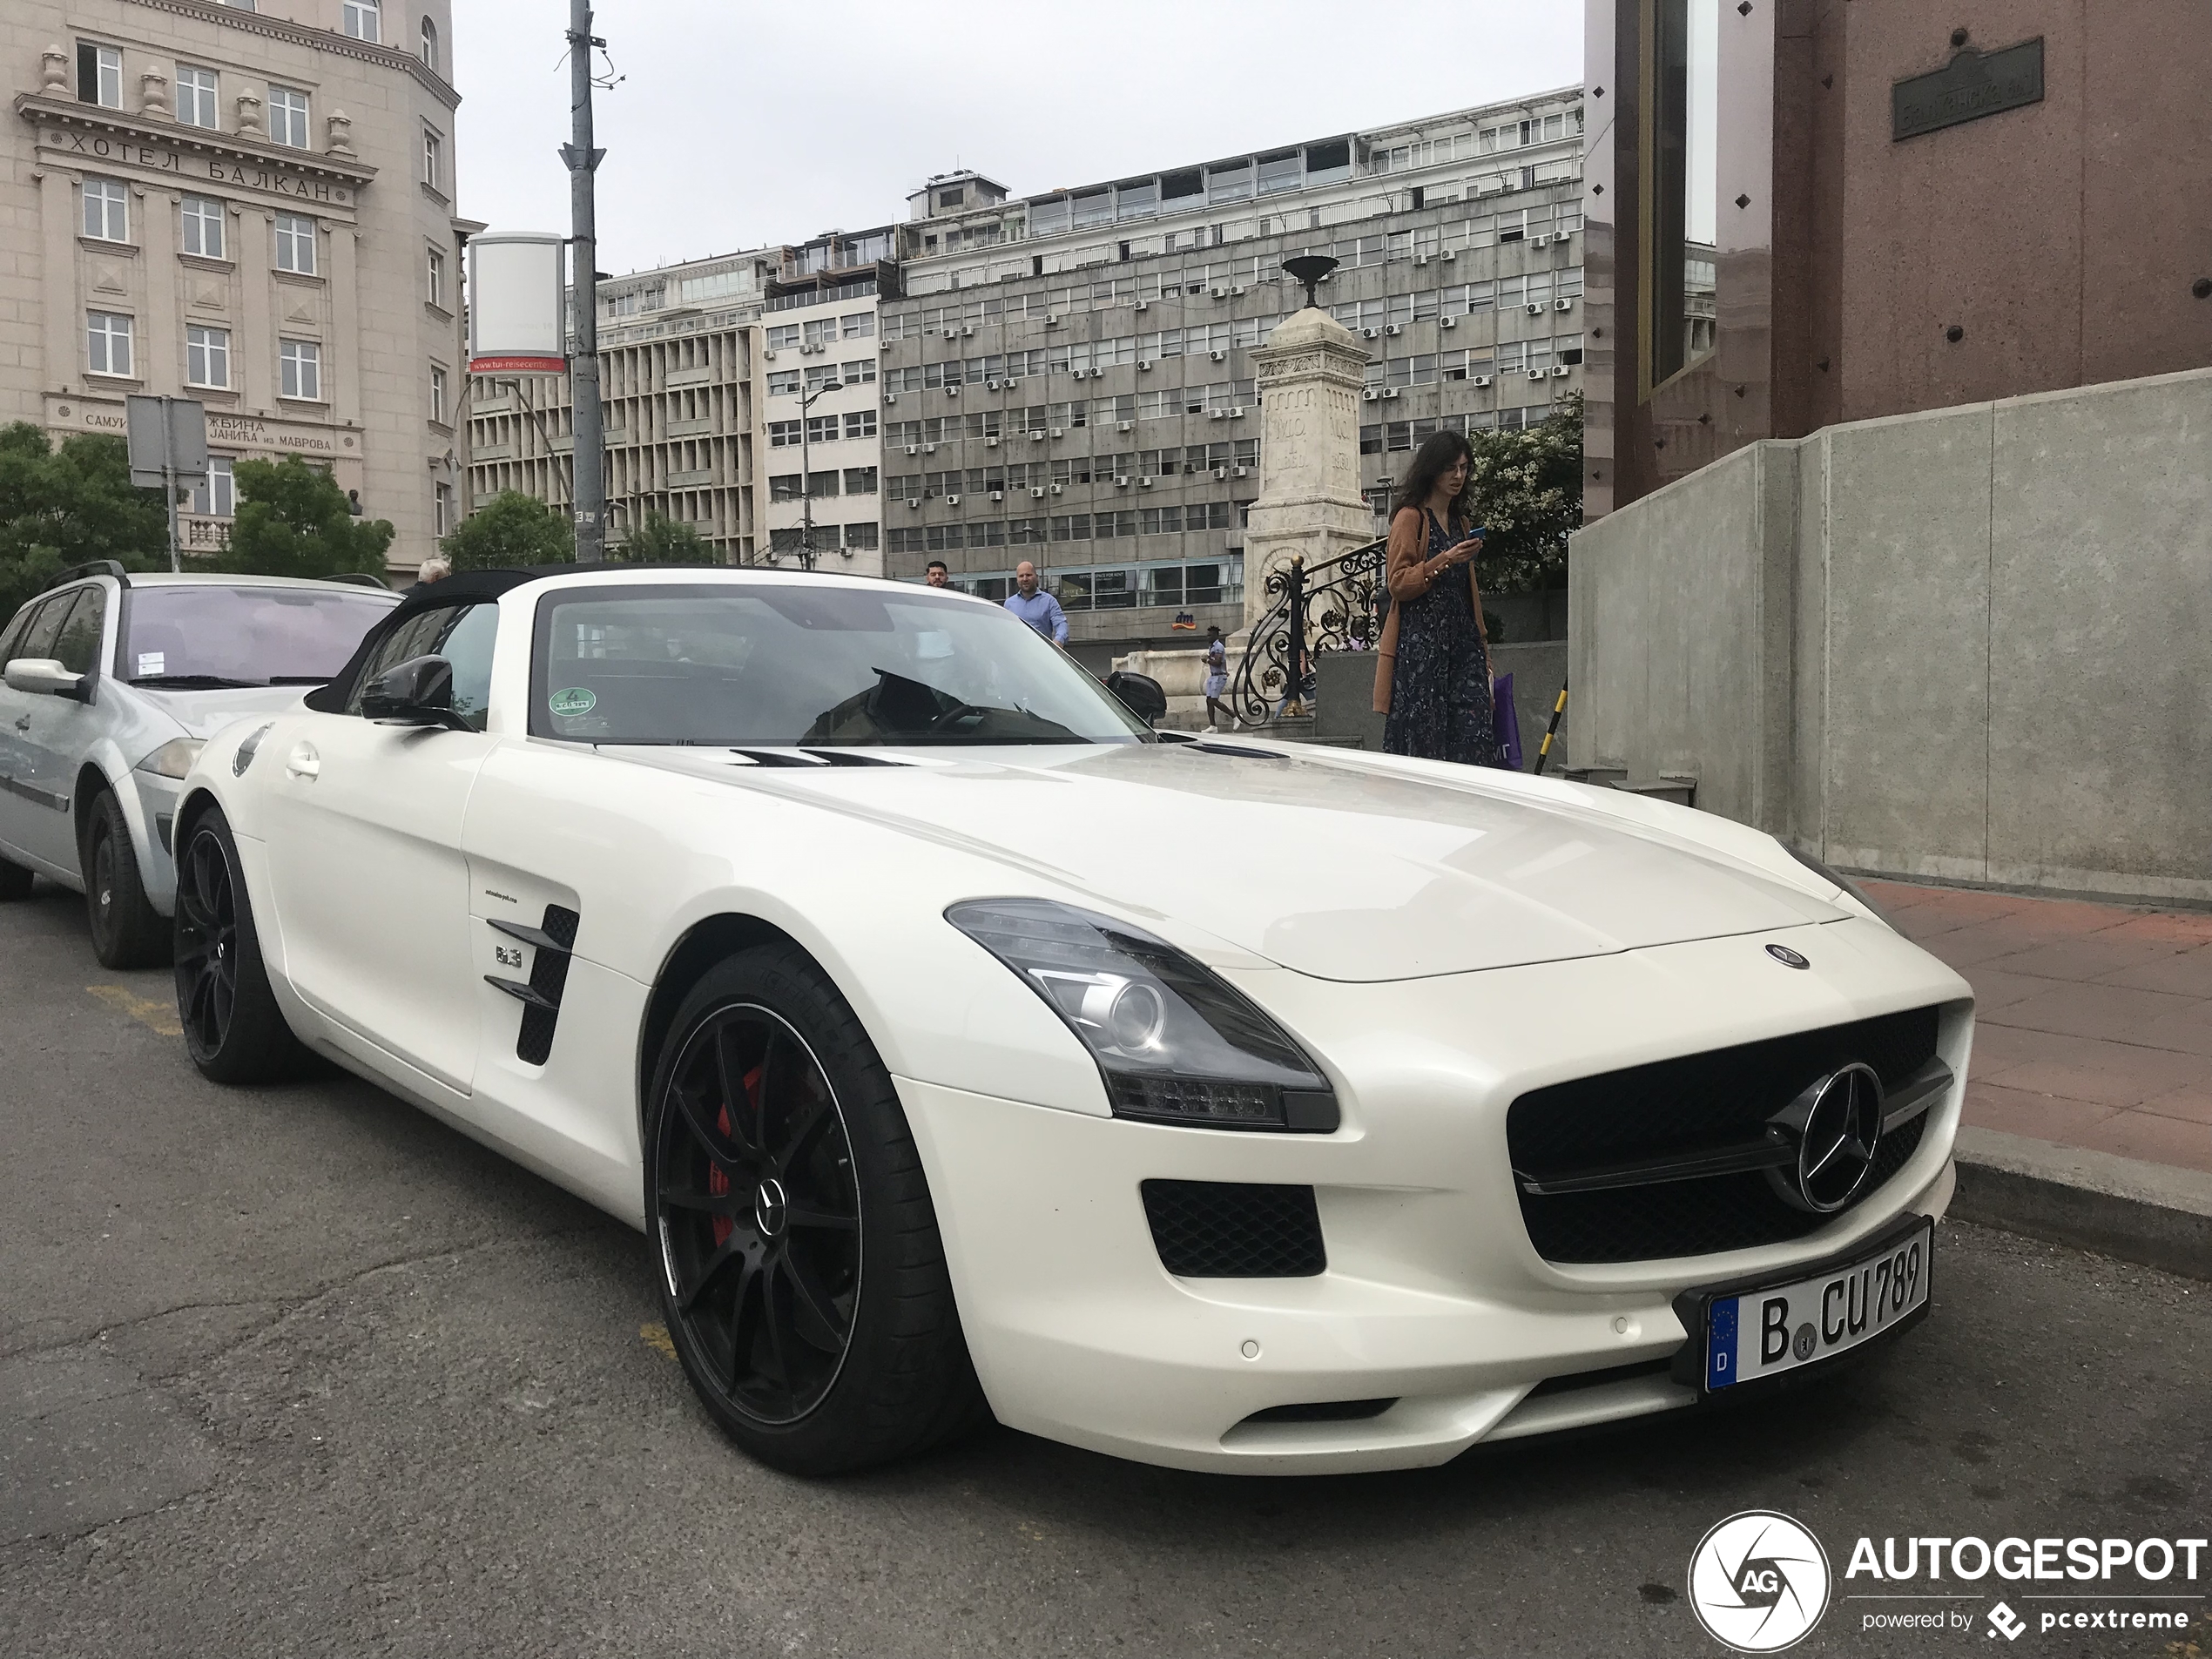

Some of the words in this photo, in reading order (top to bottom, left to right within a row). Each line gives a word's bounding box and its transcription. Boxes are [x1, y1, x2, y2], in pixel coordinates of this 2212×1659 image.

[71, 132, 180, 172] ХОТЕЛ
[208, 160, 330, 201] БАЛКАН
[279, 435, 331, 450] МАВРОВА
[1176, 611, 1193, 624] dm
[566, 689, 579, 701] 4
[1761, 1296, 1790, 1366] B
[1821, 1268, 1869, 1345] CU
[1875, 1242, 1920, 1324] 789
[1716, 1352, 1727, 1372] D
